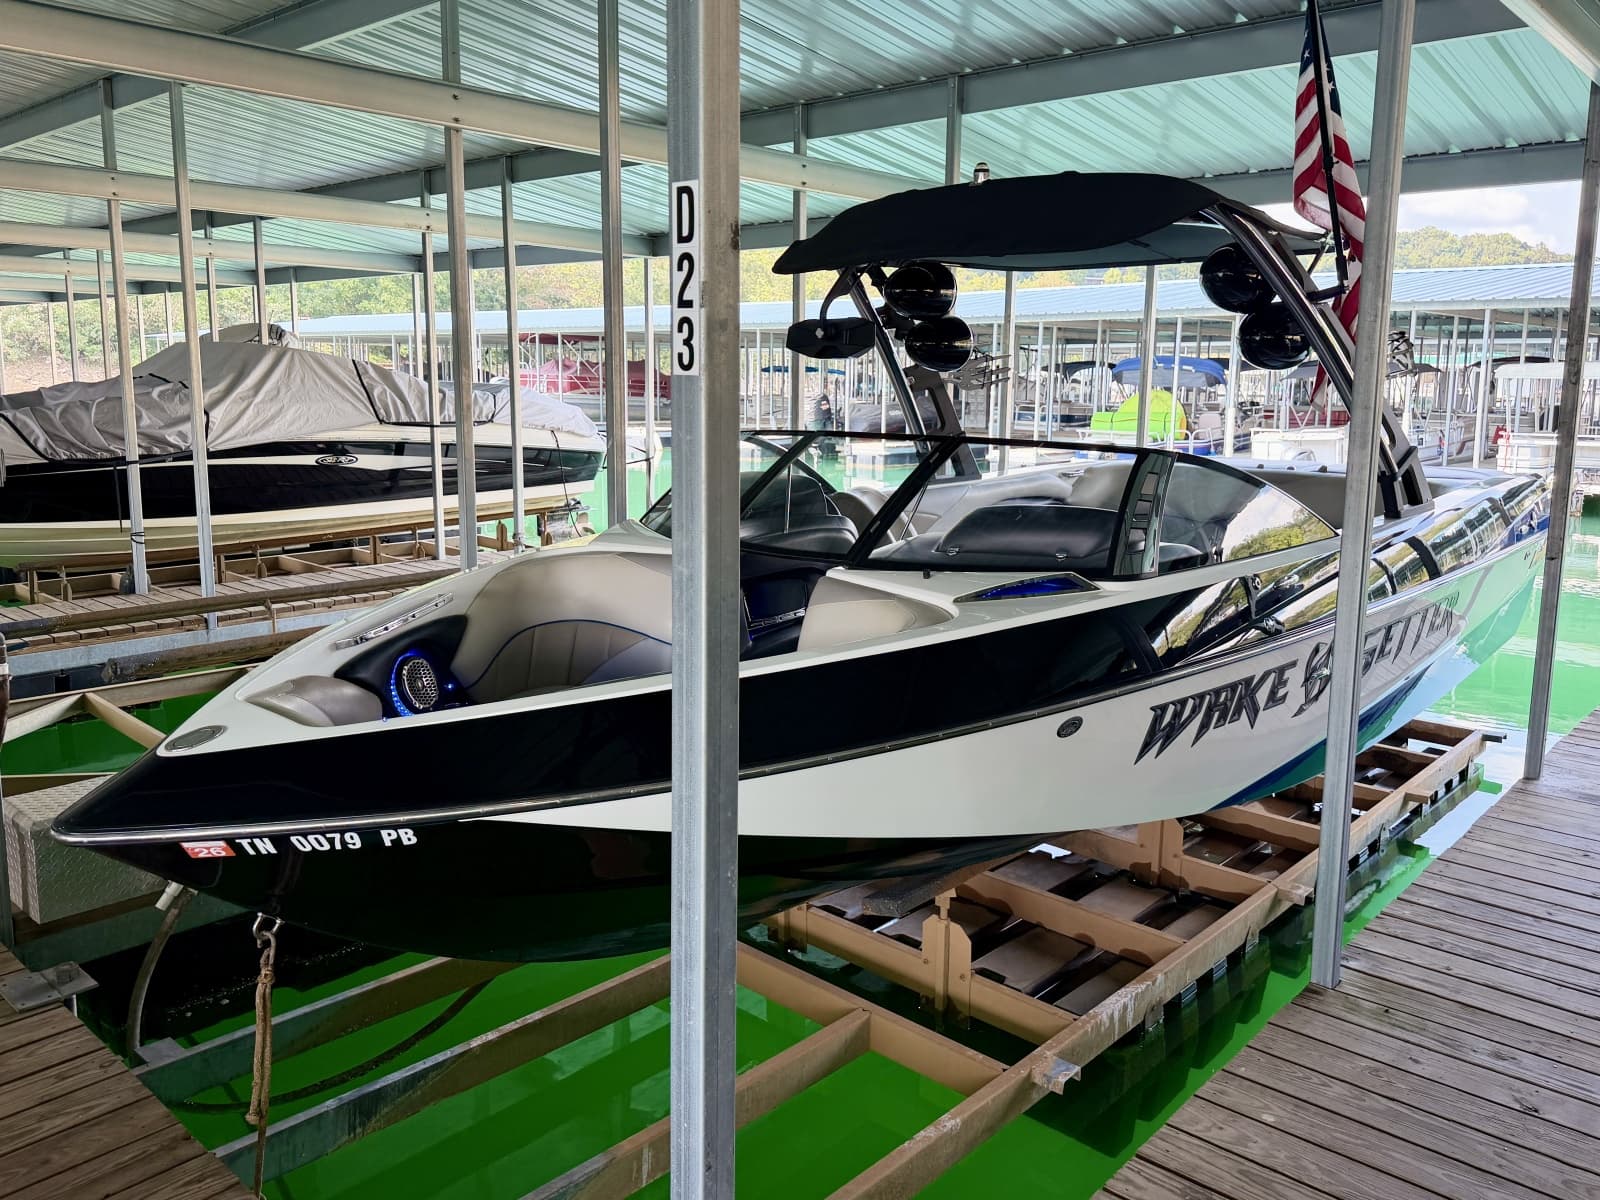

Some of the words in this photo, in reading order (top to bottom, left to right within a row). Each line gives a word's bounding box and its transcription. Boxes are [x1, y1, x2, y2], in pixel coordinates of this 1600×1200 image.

[676, 185, 695, 371] D23
[1134, 659, 1299, 765] WAKE
[235, 838, 278, 856] TN
[289, 832, 362, 852] 0079
[379, 828, 418, 847] PB
